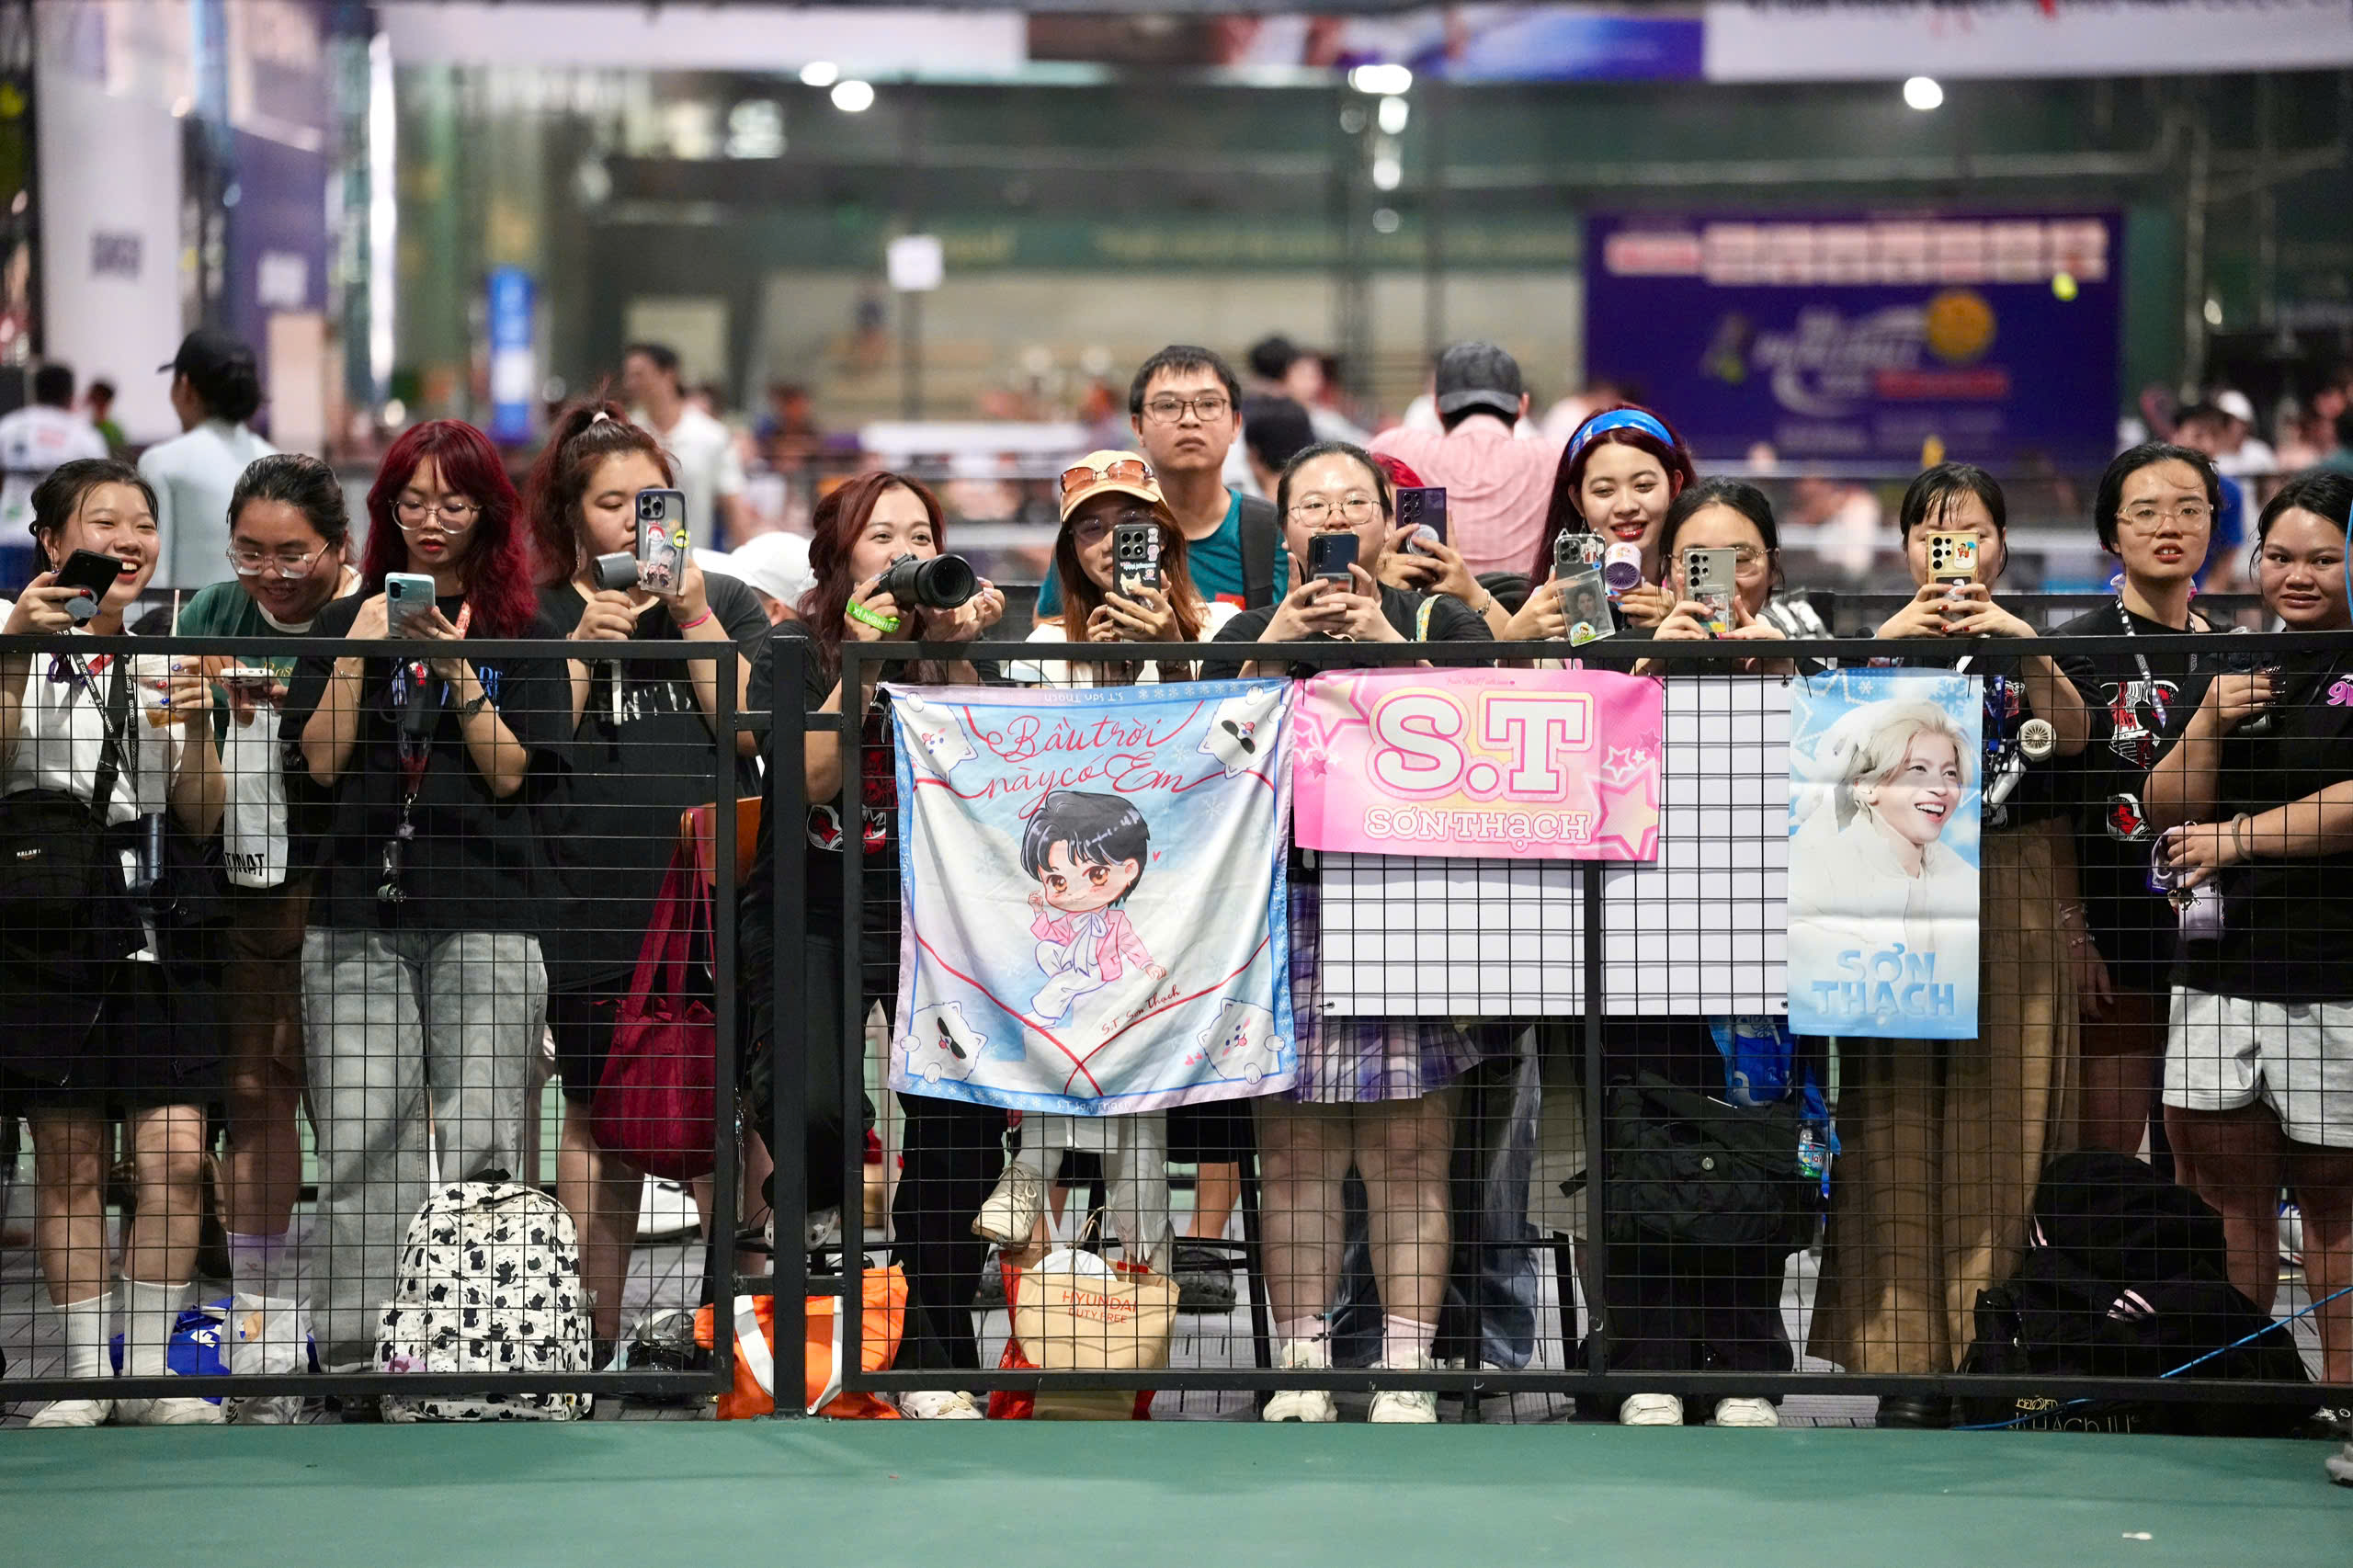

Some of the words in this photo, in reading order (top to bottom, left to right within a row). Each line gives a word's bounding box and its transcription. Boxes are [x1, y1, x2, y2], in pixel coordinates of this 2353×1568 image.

[1373, 693, 1586, 793] S.T
[1104, 752, 1184, 793] Em
[1837, 942, 1937, 983] SƠN
[1062, 1290, 1138, 1313] HYUNDAI
[1068, 1307, 1097, 1320] DUTY
[1100, 1312, 1128, 1324] FREE
